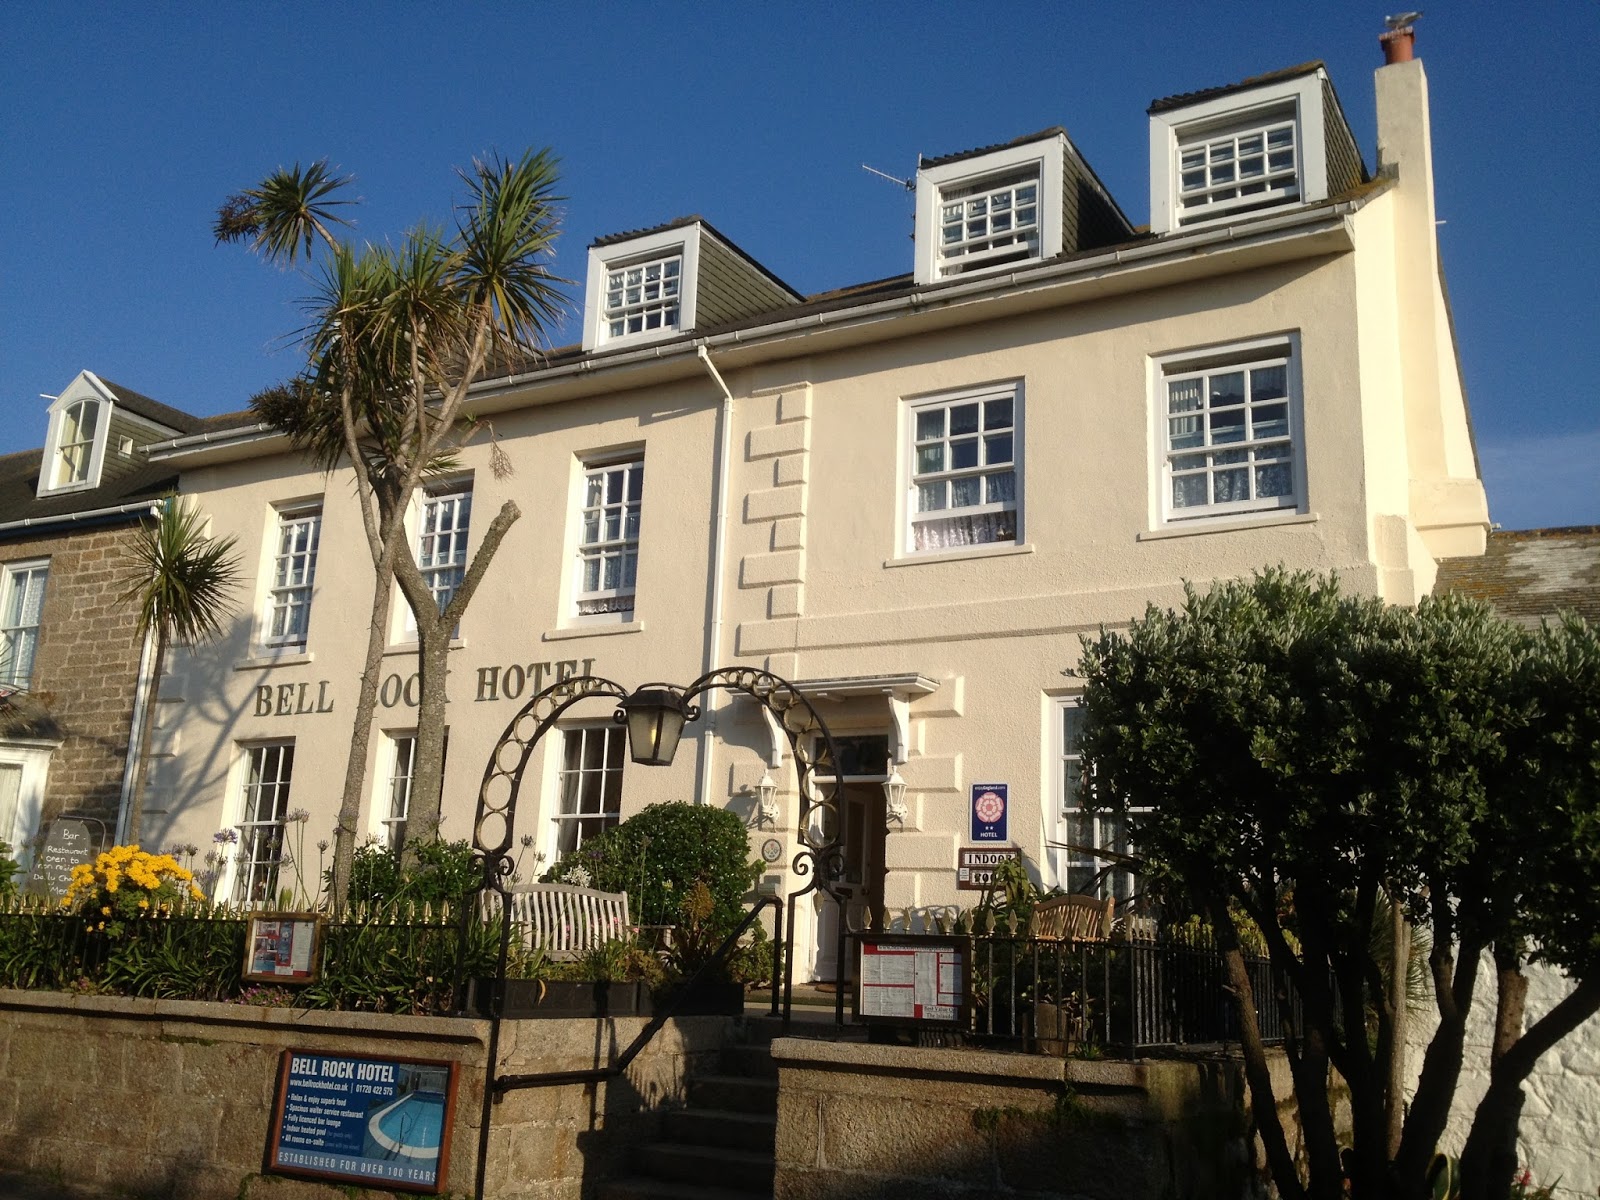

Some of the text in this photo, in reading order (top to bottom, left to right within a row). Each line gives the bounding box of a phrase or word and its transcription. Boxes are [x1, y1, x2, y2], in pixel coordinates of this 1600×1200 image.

[254, 680, 334, 716] BELL
[63, 829, 80, 840] Bar
[47, 845, 88, 856] Restaurant
[50, 886, 69, 895] Men
[291, 1057, 394, 1083] BELL ROCK HOTEL
[290, 1079, 348, 1091] www.bellrockhotel.co.uk
[372, 1086, 382, 1095] 422
[383, 1087, 393, 1096] 575
[308, 1096, 320, 1104] enjoy
[320, 1098, 336, 1106] superb
[289, 1103, 364, 1118] Spacious waiter service restaurant
[287, 1114, 298, 1123] Fully
[318, 1117, 326, 1125] bar
[326, 1118, 341, 1128] lounge
[286, 1124, 300, 1132] Indoor
[301, 1126, 316, 1135] heated
[316, 1128, 326, 1136] pool
[291, 1136, 305, 1144] rooms
[305, 1138, 324, 1146] en-suite
[279, 1151, 436, 1182] ESTABLISHED FOR OVER 100 YEARS
